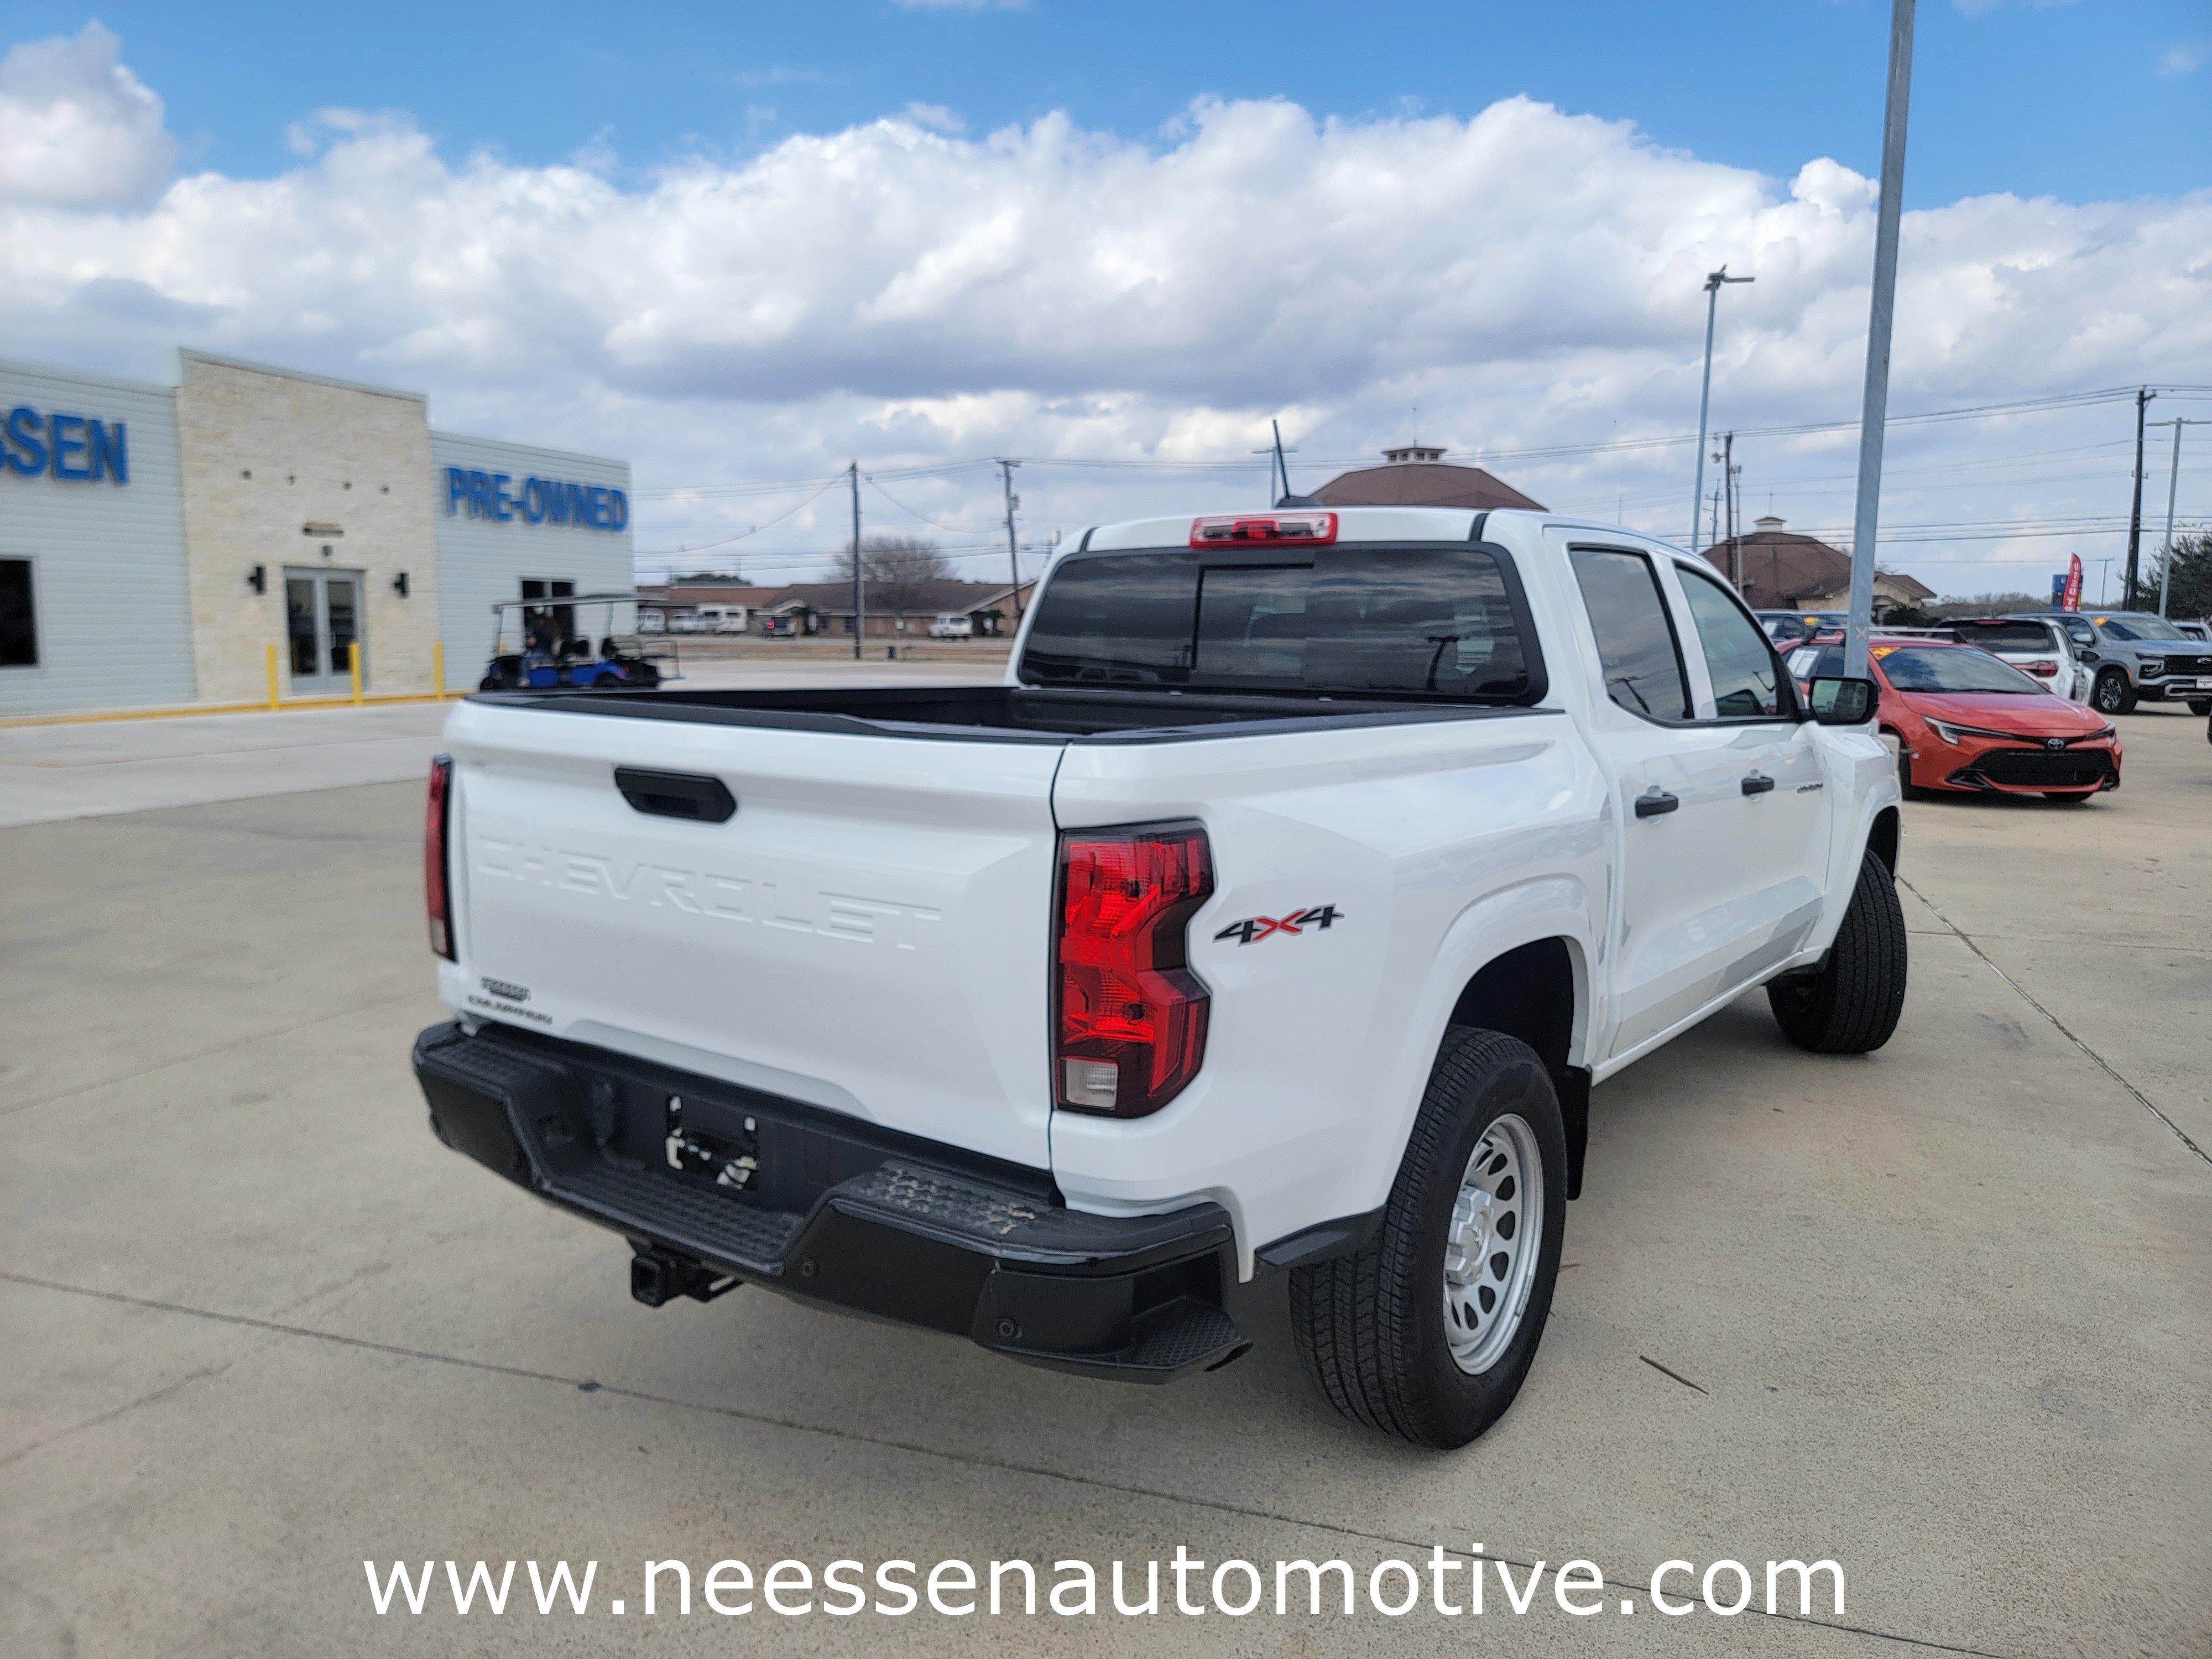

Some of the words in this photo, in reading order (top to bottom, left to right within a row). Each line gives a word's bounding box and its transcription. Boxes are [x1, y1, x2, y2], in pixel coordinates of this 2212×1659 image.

[0, 408, 129, 486] SEN
[444, 467, 629, 533] PRE-OWNED
[478, 836, 942, 950] CHEVROLET
